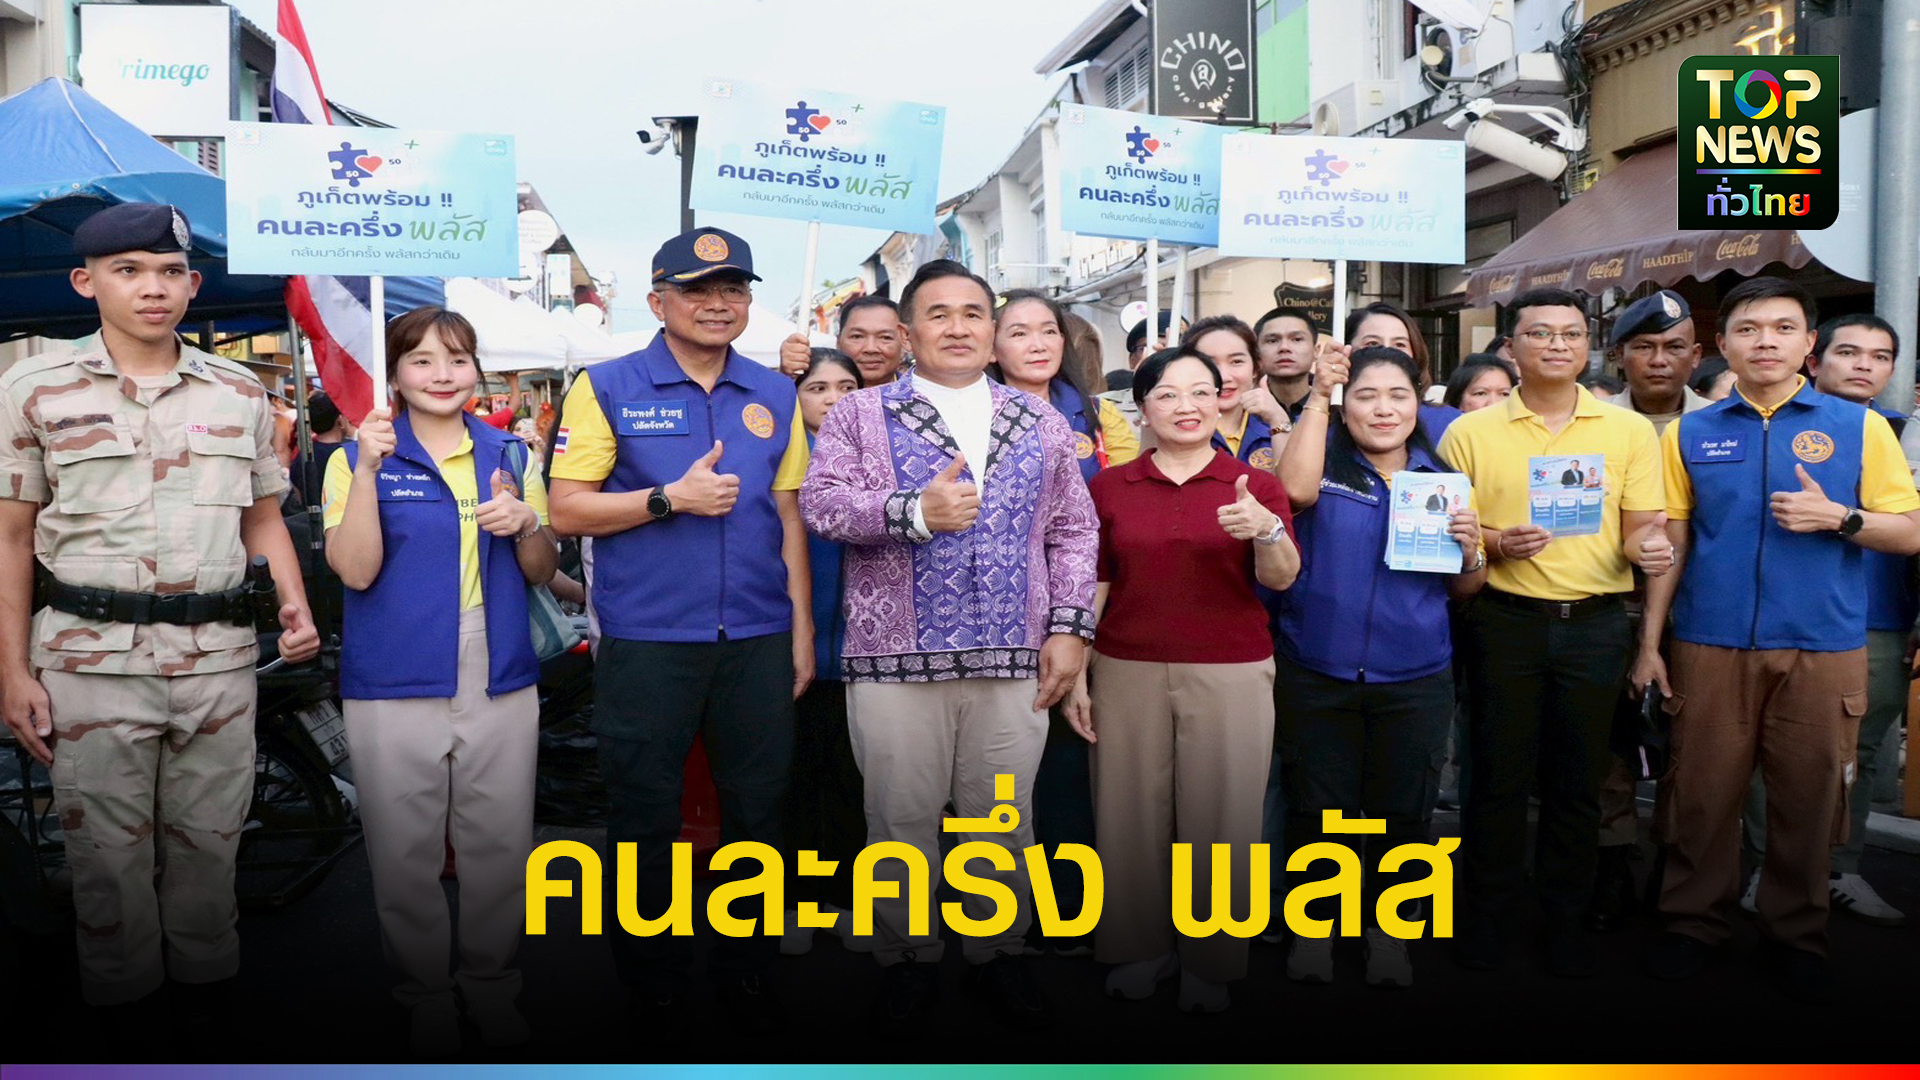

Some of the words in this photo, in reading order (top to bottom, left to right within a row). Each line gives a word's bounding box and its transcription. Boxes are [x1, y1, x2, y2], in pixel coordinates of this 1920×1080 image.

[1160, 31, 1246, 70] CHINO
[118, 58, 209, 87] rimego
[755, 139, 866, 165] ภูเก็ตพร้อม
[718, 164, 840, 190] คนละครึ่ง
[845, 172, 913, 200] พลัส
[1105, 162, 1187, 185] ภูเก็ตพร้อม
[297, 186, 430, 208] ภูเก็ตพร้อม
[1079, 185, 1170, 208] คนละครึ่ง
[1277, 185, 1389, 204] ภูเก็ตพร้อม
[257, 210, 402, 238] คนละครึ่ง
[410, 213, 488, 242] พลัส
[1243, 205, 1364, 228] คนละครึ่ง
[291, 245, 381, 259] กลับมาอีกครั้ง
[384, 247, 460, 260] พลัสกว่าเดิม
